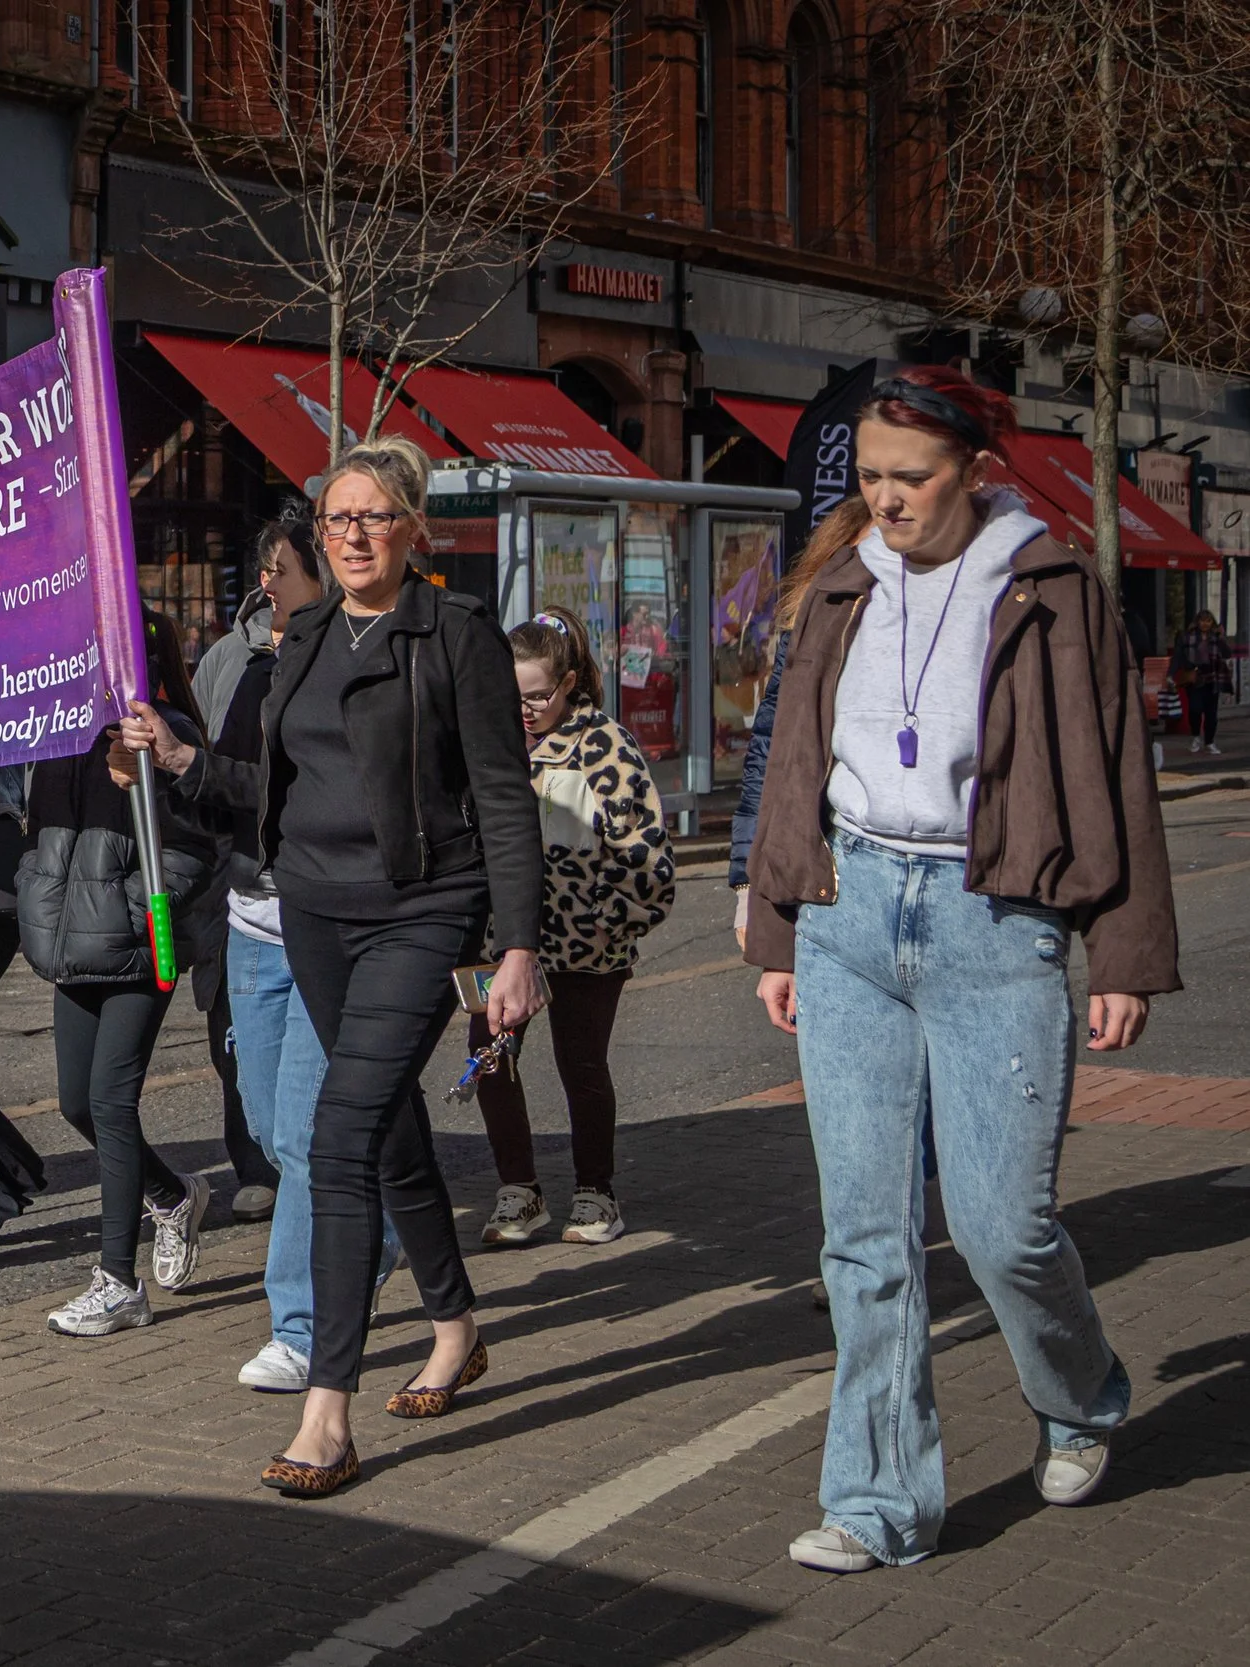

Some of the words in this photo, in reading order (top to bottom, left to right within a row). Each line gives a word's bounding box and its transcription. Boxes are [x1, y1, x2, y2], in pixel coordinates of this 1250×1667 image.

[577, 263, 664, 304] HAYMARKET
[19, 378, 74, 449] WO
[54, 455, 81, 498] Sinc
[483, 441, 630, 475] HAYMARKET
[810, 422, 851, 529] NESS
[0, 652, 86, 699] heroines
